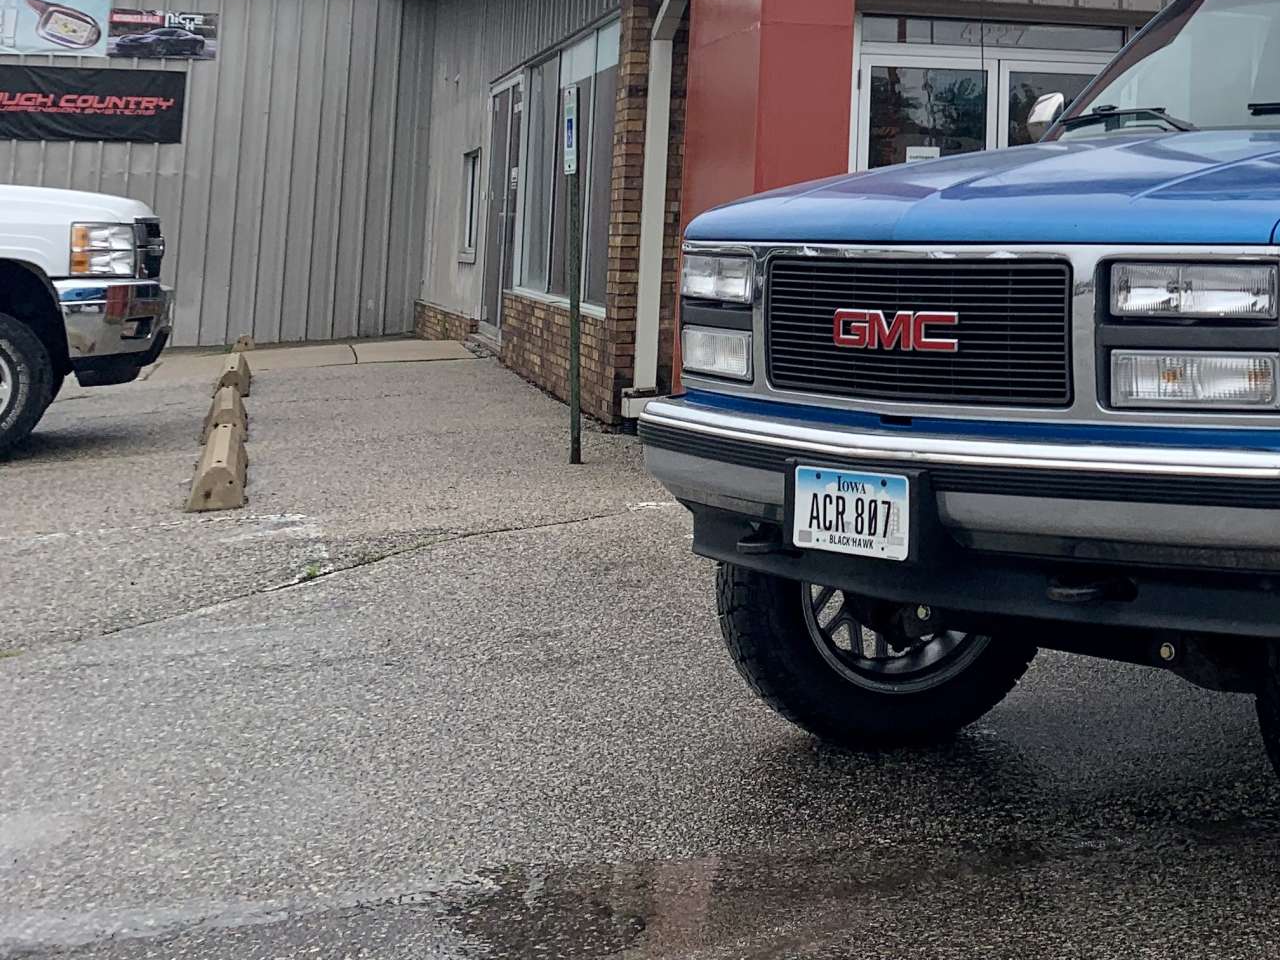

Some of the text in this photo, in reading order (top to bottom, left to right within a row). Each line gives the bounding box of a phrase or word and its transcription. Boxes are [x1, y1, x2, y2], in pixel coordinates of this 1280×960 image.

[59, 94, 175, 110] COUNTRY
[833, 308, 959, 352] GMC
[808, 492, 891, 538] ACR 807
[829, 533, 874, 550] BLACK HAWK
